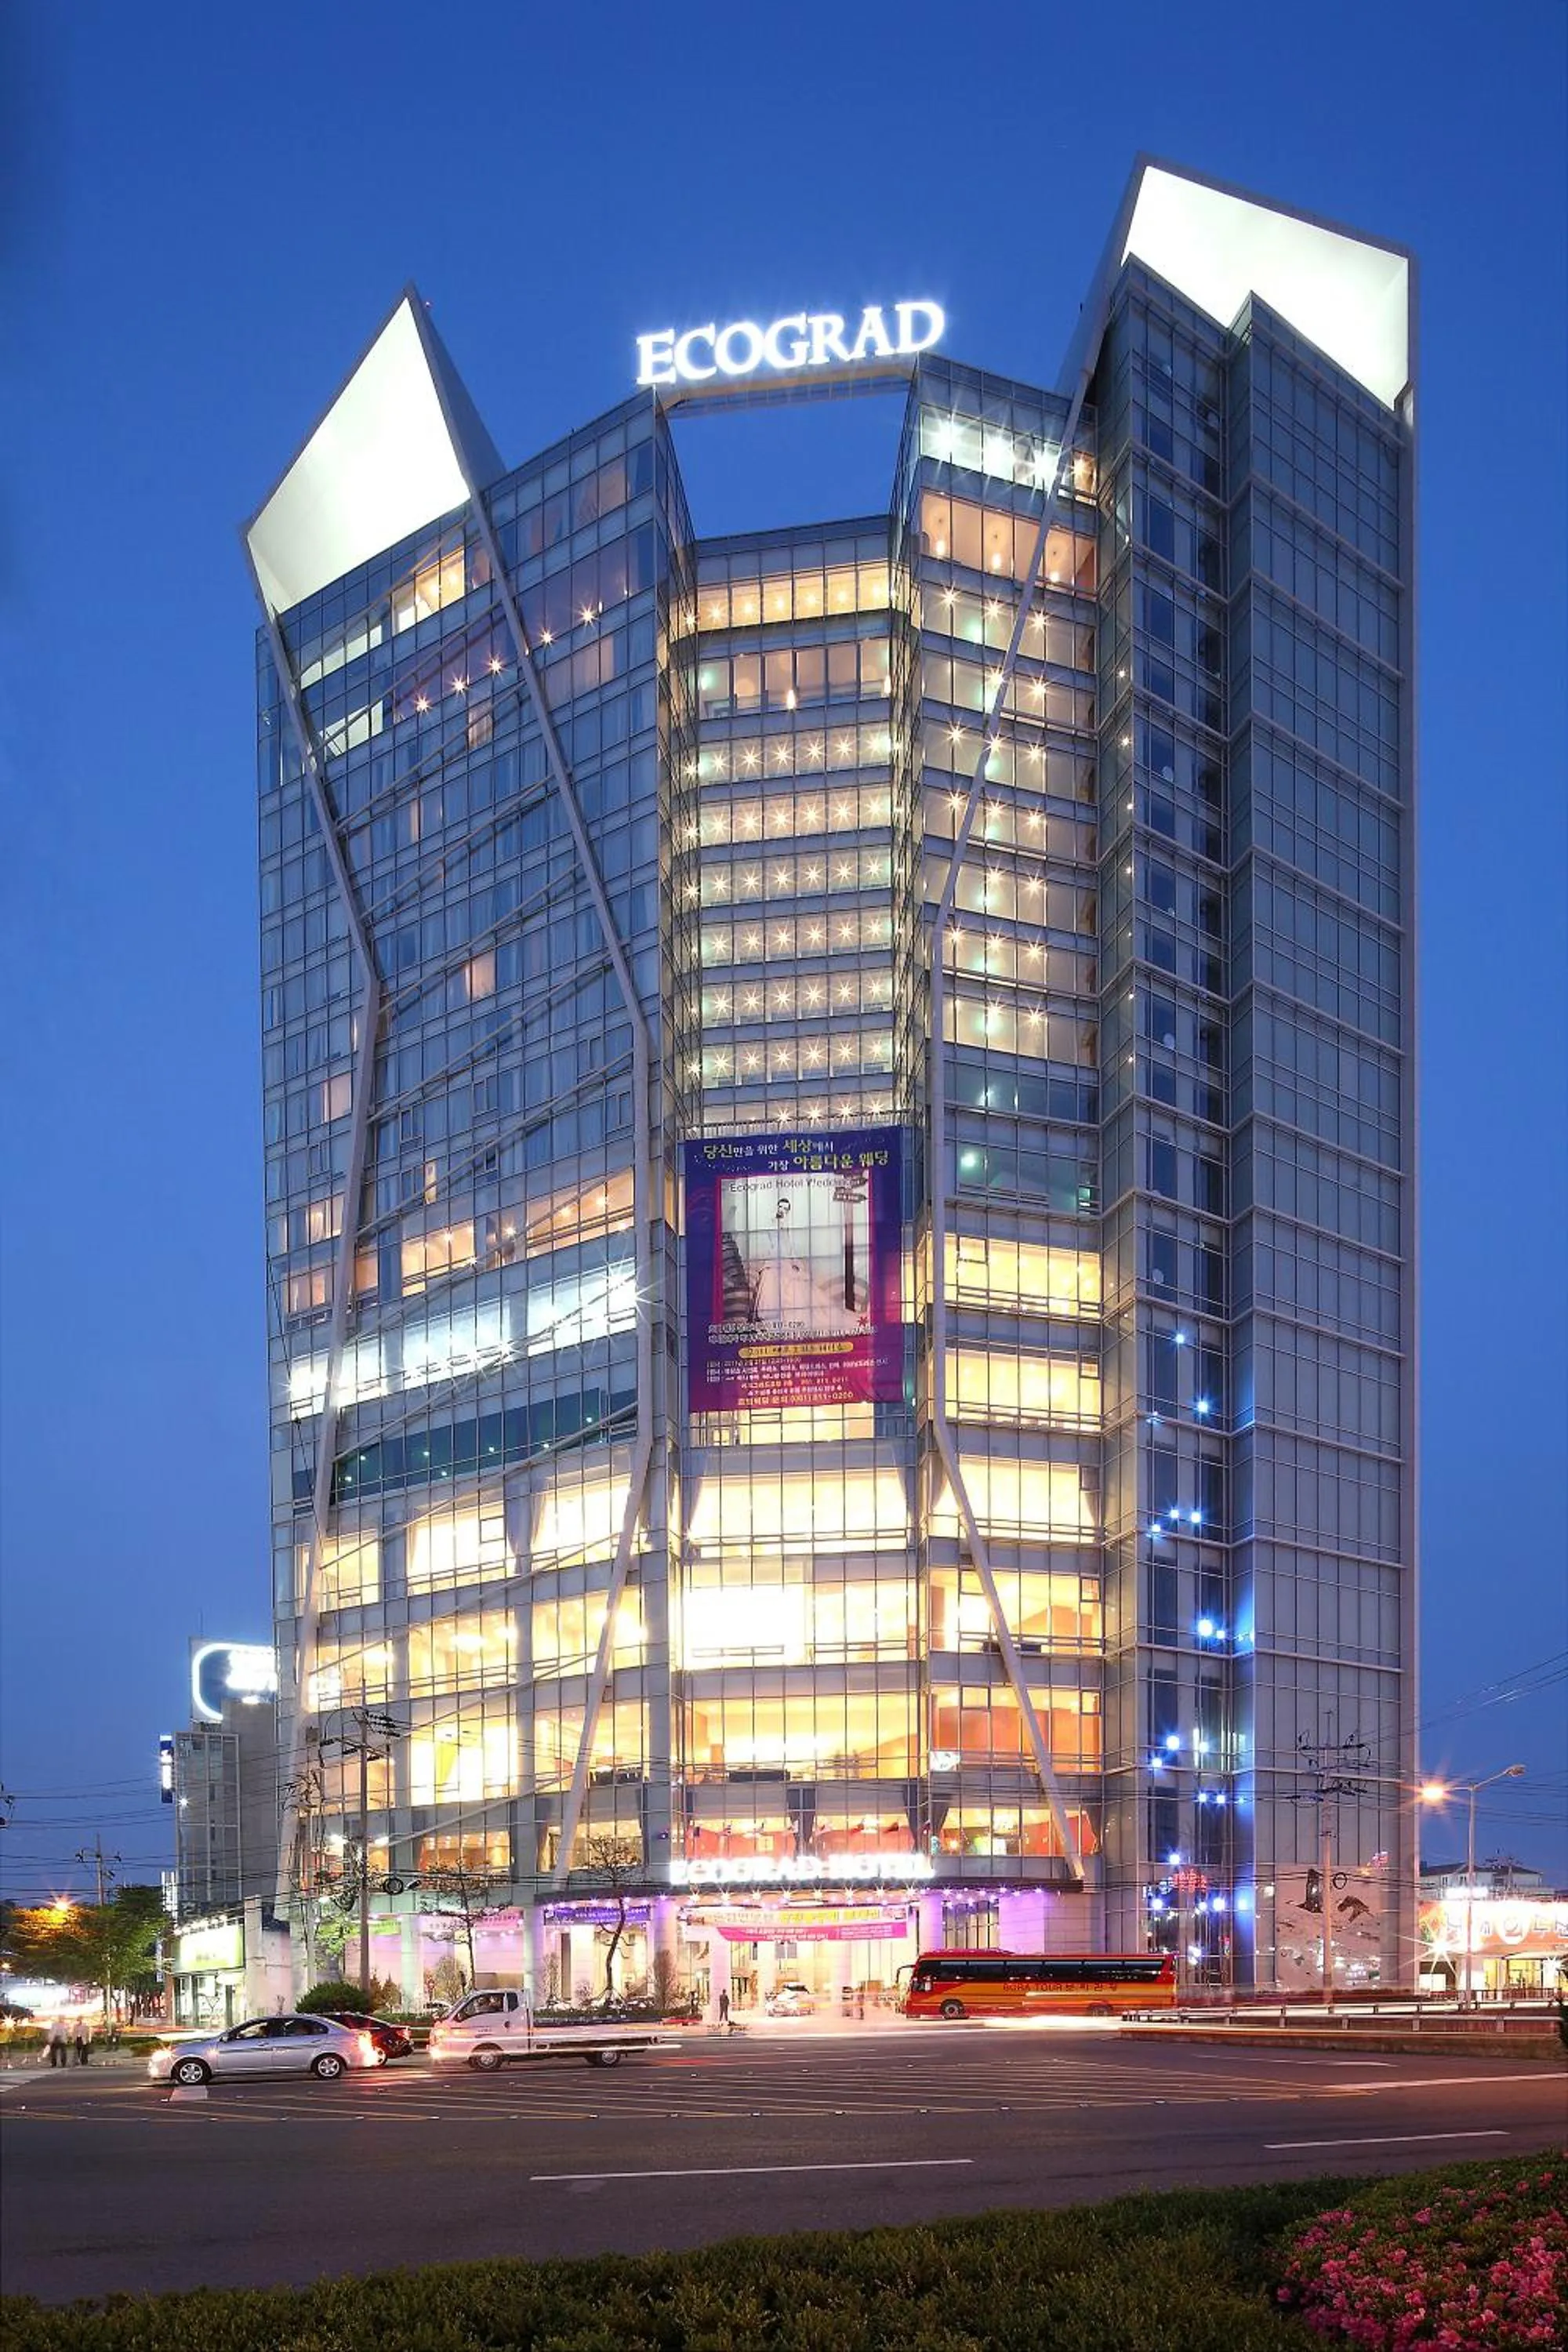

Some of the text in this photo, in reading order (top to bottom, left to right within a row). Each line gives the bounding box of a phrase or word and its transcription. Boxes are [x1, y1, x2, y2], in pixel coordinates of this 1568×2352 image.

[636, 302, 945, 384] ECOGRAD
[704, 1139, 833, 1160] 당신만을 위한 세상에서
[768, 1150, 888, 1171] 가장 아름다운 웨딩
